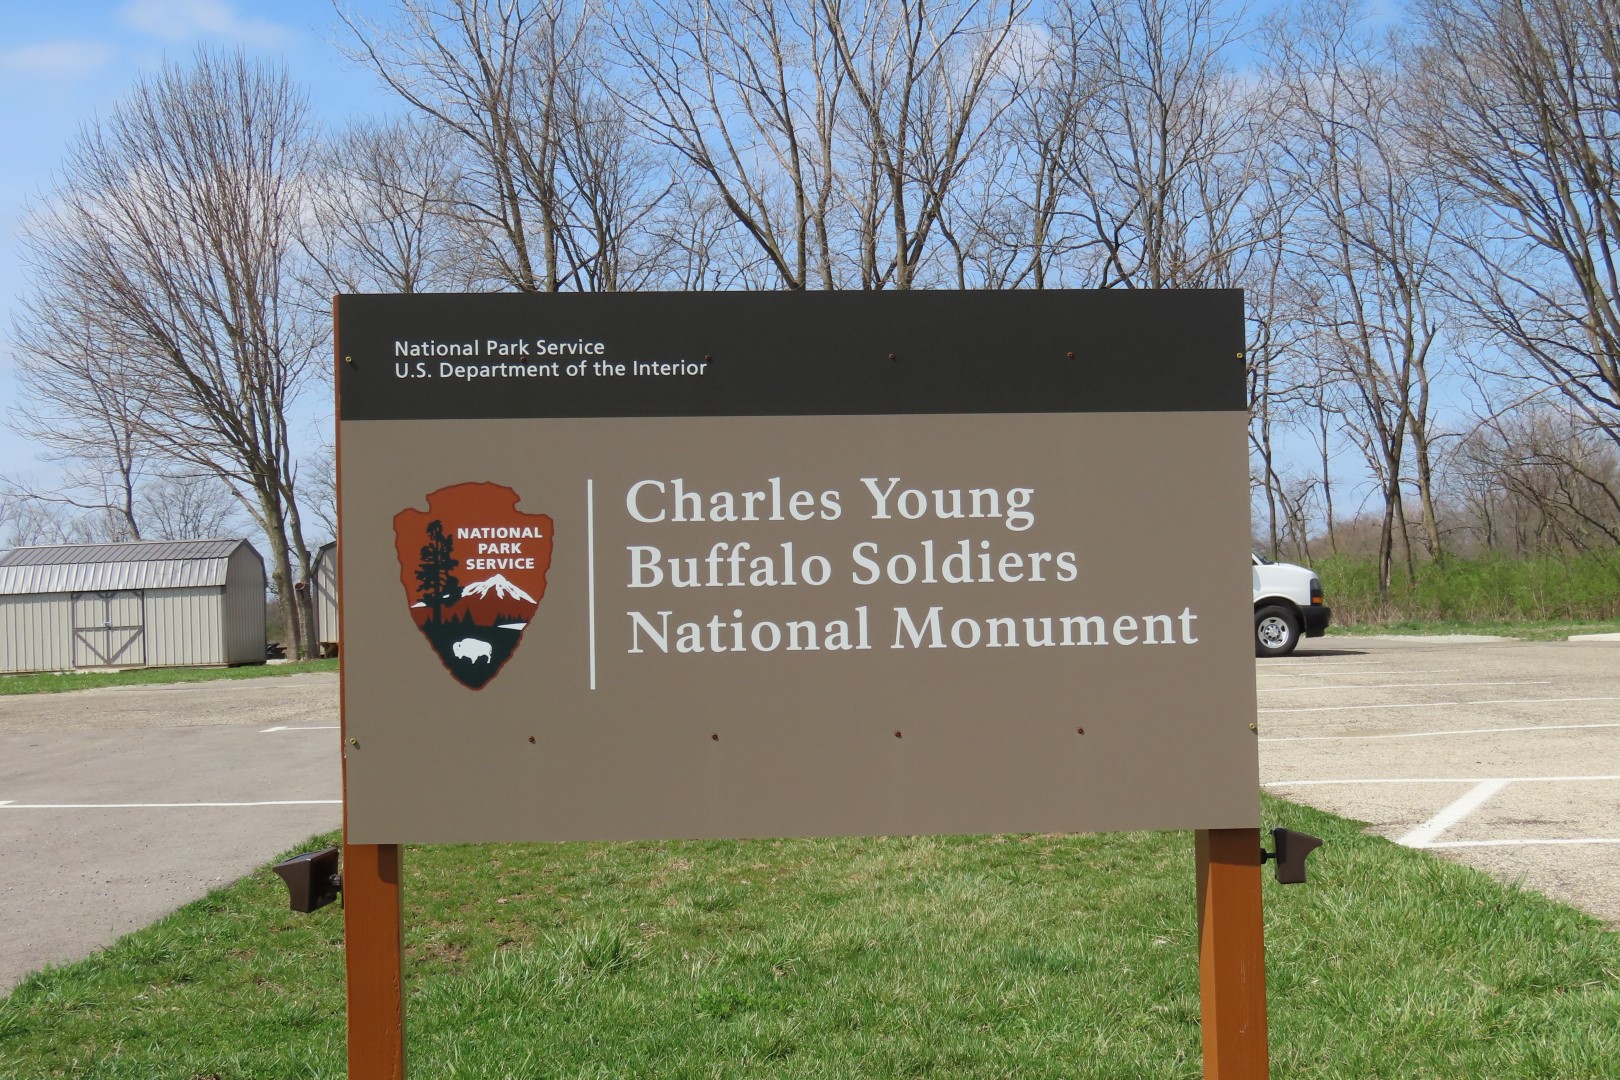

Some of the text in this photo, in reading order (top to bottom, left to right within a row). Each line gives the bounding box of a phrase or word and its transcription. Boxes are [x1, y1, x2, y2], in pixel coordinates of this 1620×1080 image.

[395, 338, 605, 357] National Park Service
[395, 359, 708, 382] U.S. Department of the Interior
[626, 476, 1035, 532] Charles Young
[457, 526, 543, 540] NATIONAL
[478, 542, 522, 555] PARK
[465, 557, 535, 571] SERVICE
[626, 538, 1078, 588] Buffalo Soldiers
[626, 605, 1199, 654] National Monument
